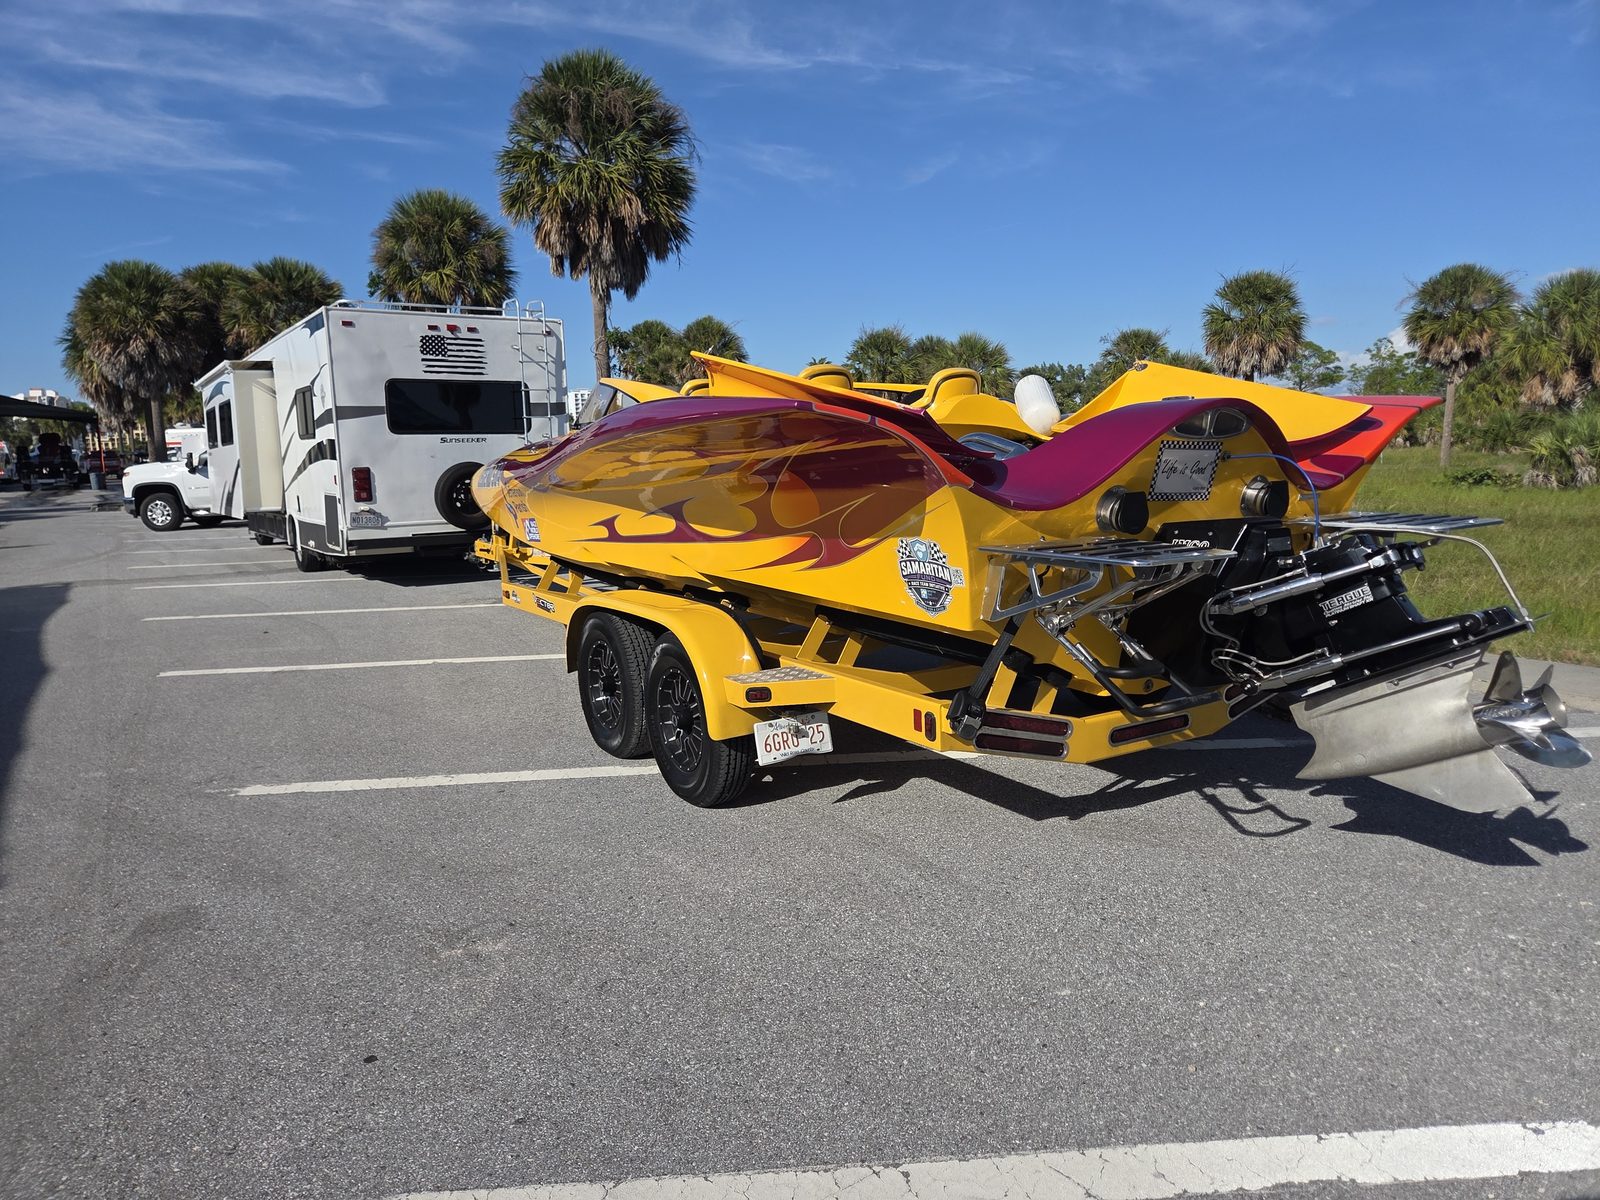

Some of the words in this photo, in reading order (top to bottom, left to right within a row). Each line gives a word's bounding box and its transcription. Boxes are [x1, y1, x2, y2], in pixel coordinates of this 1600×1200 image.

[1180, 463, 1188, 475] is
[901, 561, 950, 581] SAMARITAN
[1319, 585, 1371, 611] TEAGUE
[808, 724, 825, 745] 25
